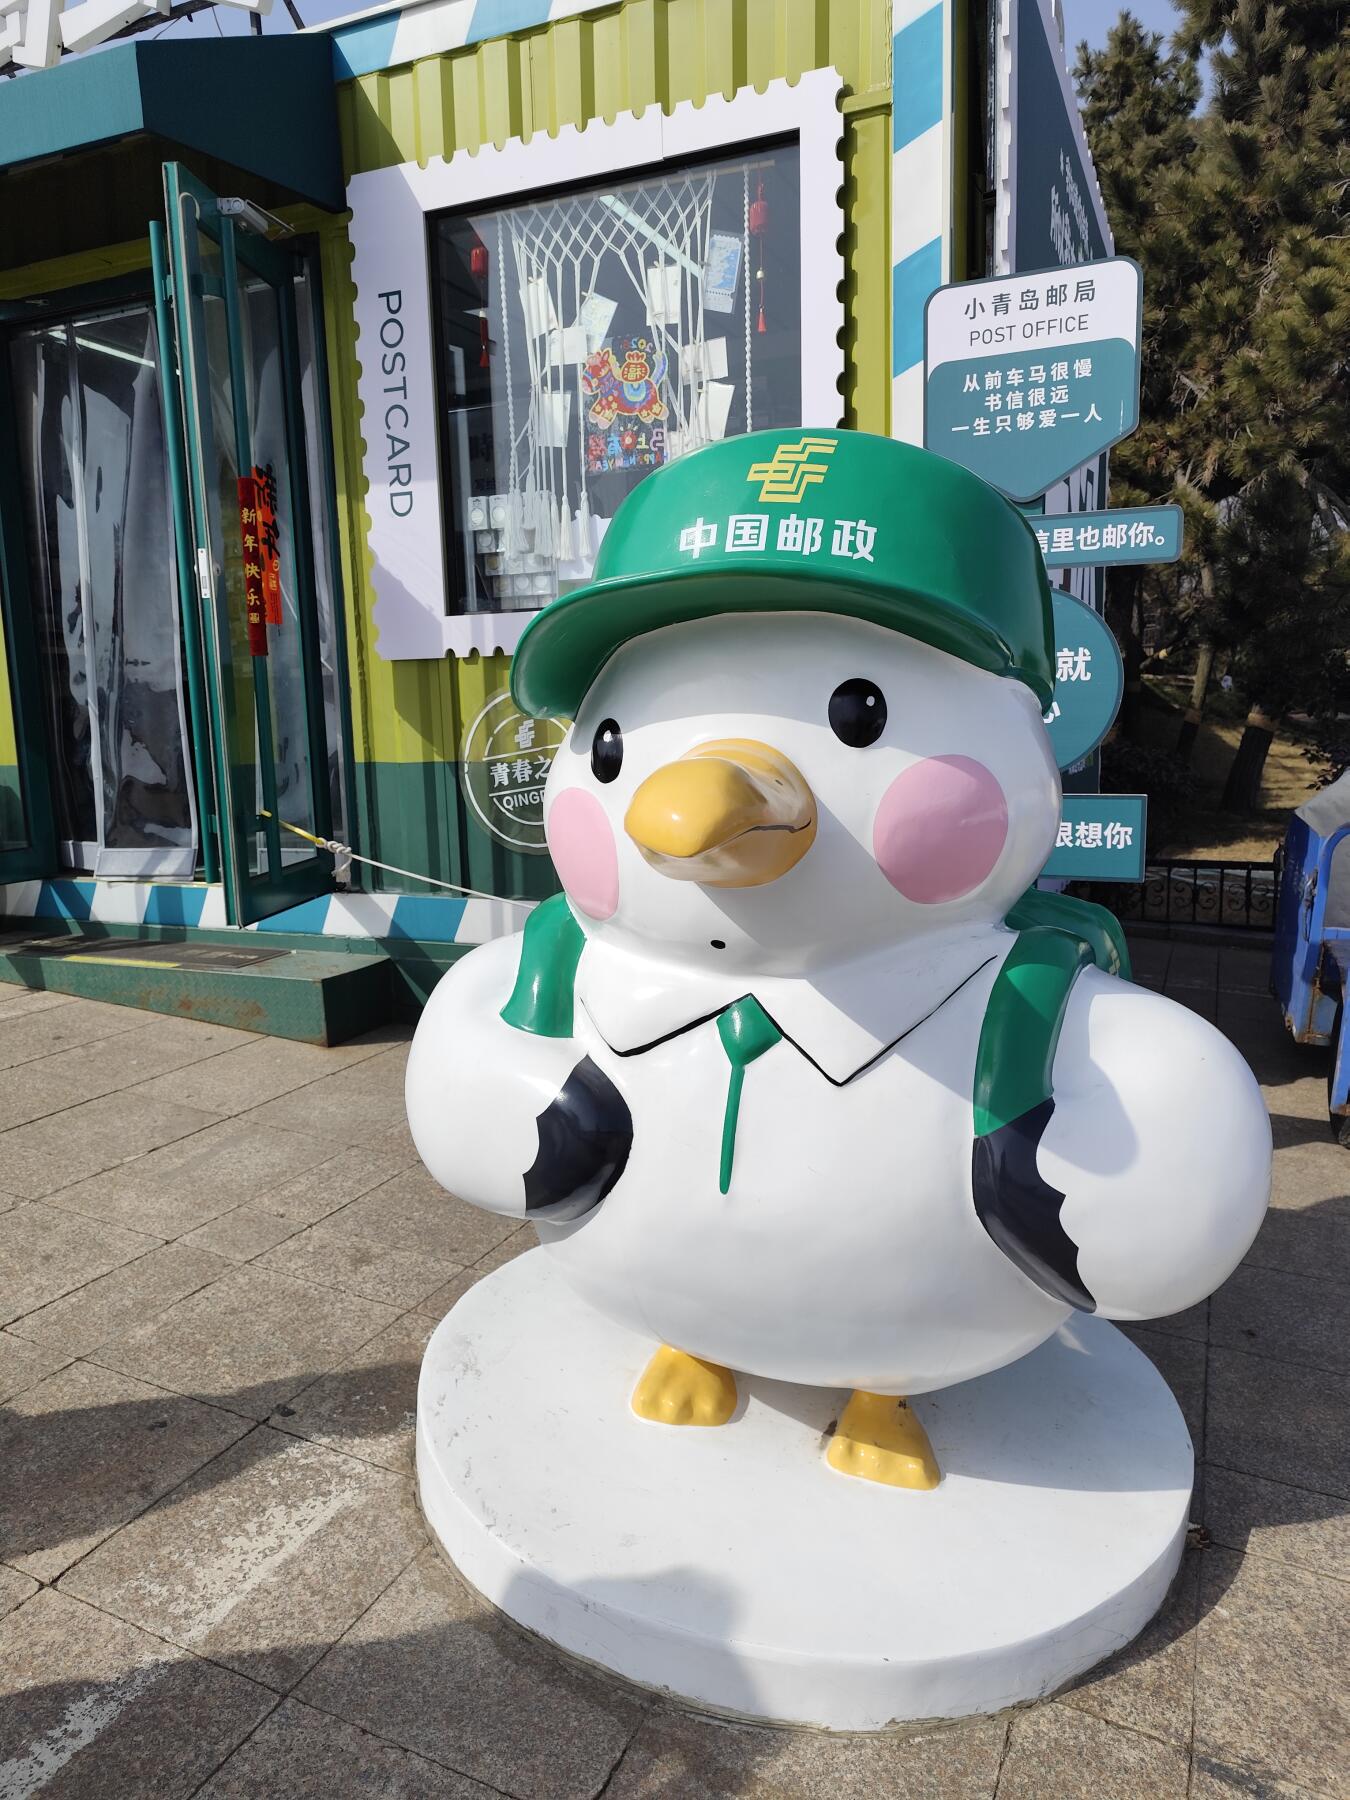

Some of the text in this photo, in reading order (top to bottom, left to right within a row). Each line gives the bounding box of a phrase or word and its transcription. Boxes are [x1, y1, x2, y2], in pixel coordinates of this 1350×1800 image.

[964, 279, 1096, 321] 小青岛邮局
[970, 314, 1089, 346] POST OFFICE
[963, 358, 1093, 393] 从前车马很慢
[377, 289, 413, 519] POSTCARD
[984, 385, 1070, 413] 书信很远
[951, 403, 1102, 437] 一生只够爱一人
[679, 513, 878, 563] 中国邮政
[241, 507, 262, 607] 新年快乐
[1056, 646, 1092, 682] 就
